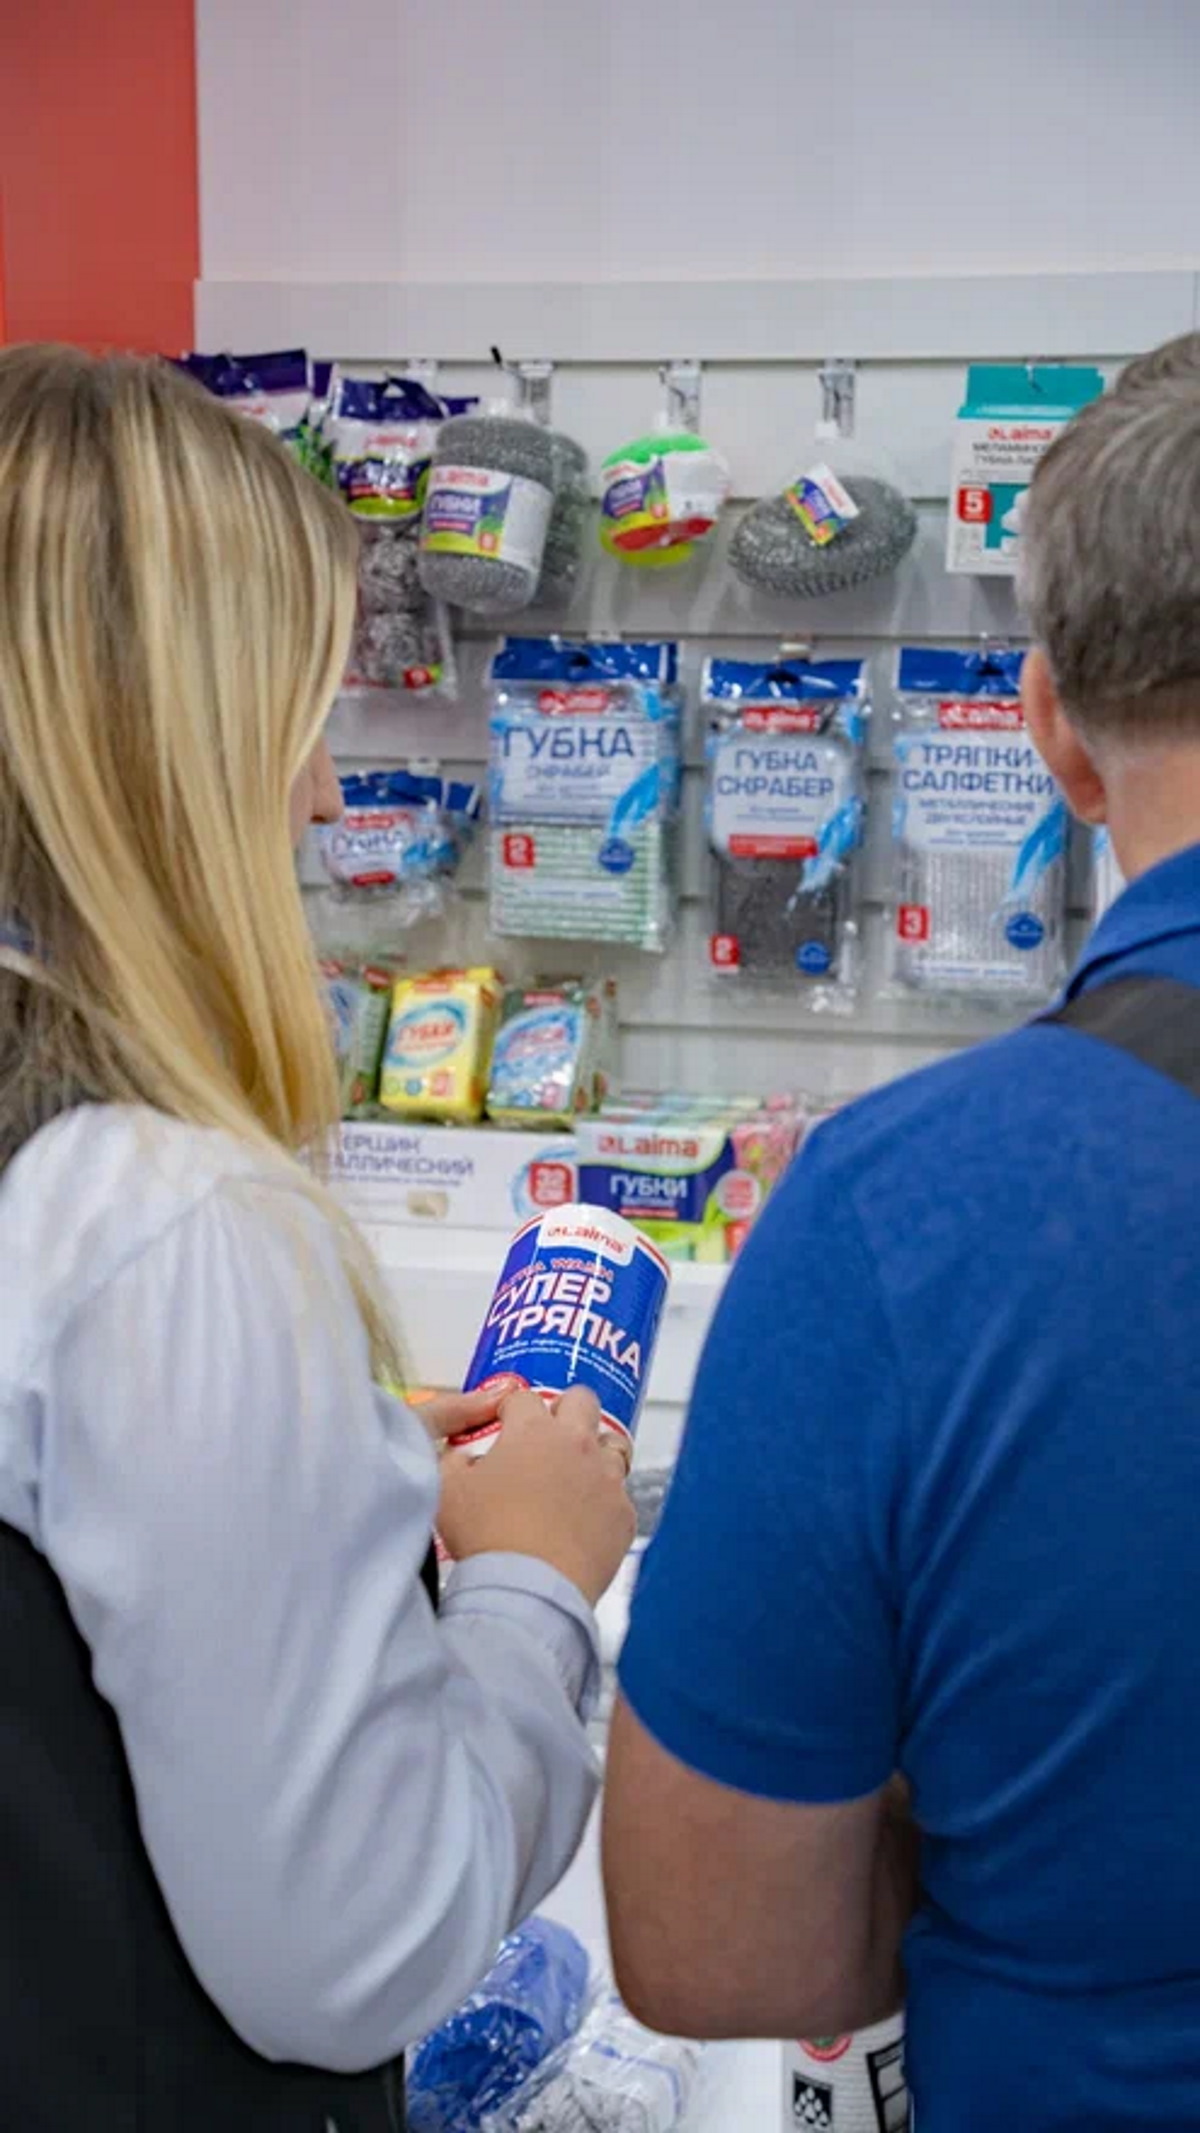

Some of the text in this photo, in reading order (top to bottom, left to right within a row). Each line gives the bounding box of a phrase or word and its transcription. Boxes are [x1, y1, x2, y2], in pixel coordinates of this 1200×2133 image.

[965, 489, 984, 512] 5
[503, 726, 634, 758] ГУБКА
[734, 749, 818, 772] ГУБКА
[716, 774, 834, 797] СКРАБЕР
[902, 769, 1056, 796] САЛФЕТКИ
[904, 910, 922, 936] 3
[620, 1134, 698, 1158] Laima
[610, 1174, 687, 1198] ГУБКИ
[487, 1271, 613, 1328] СУПЕР
[497, 1303, 641, 1381] ТРЯПКА
